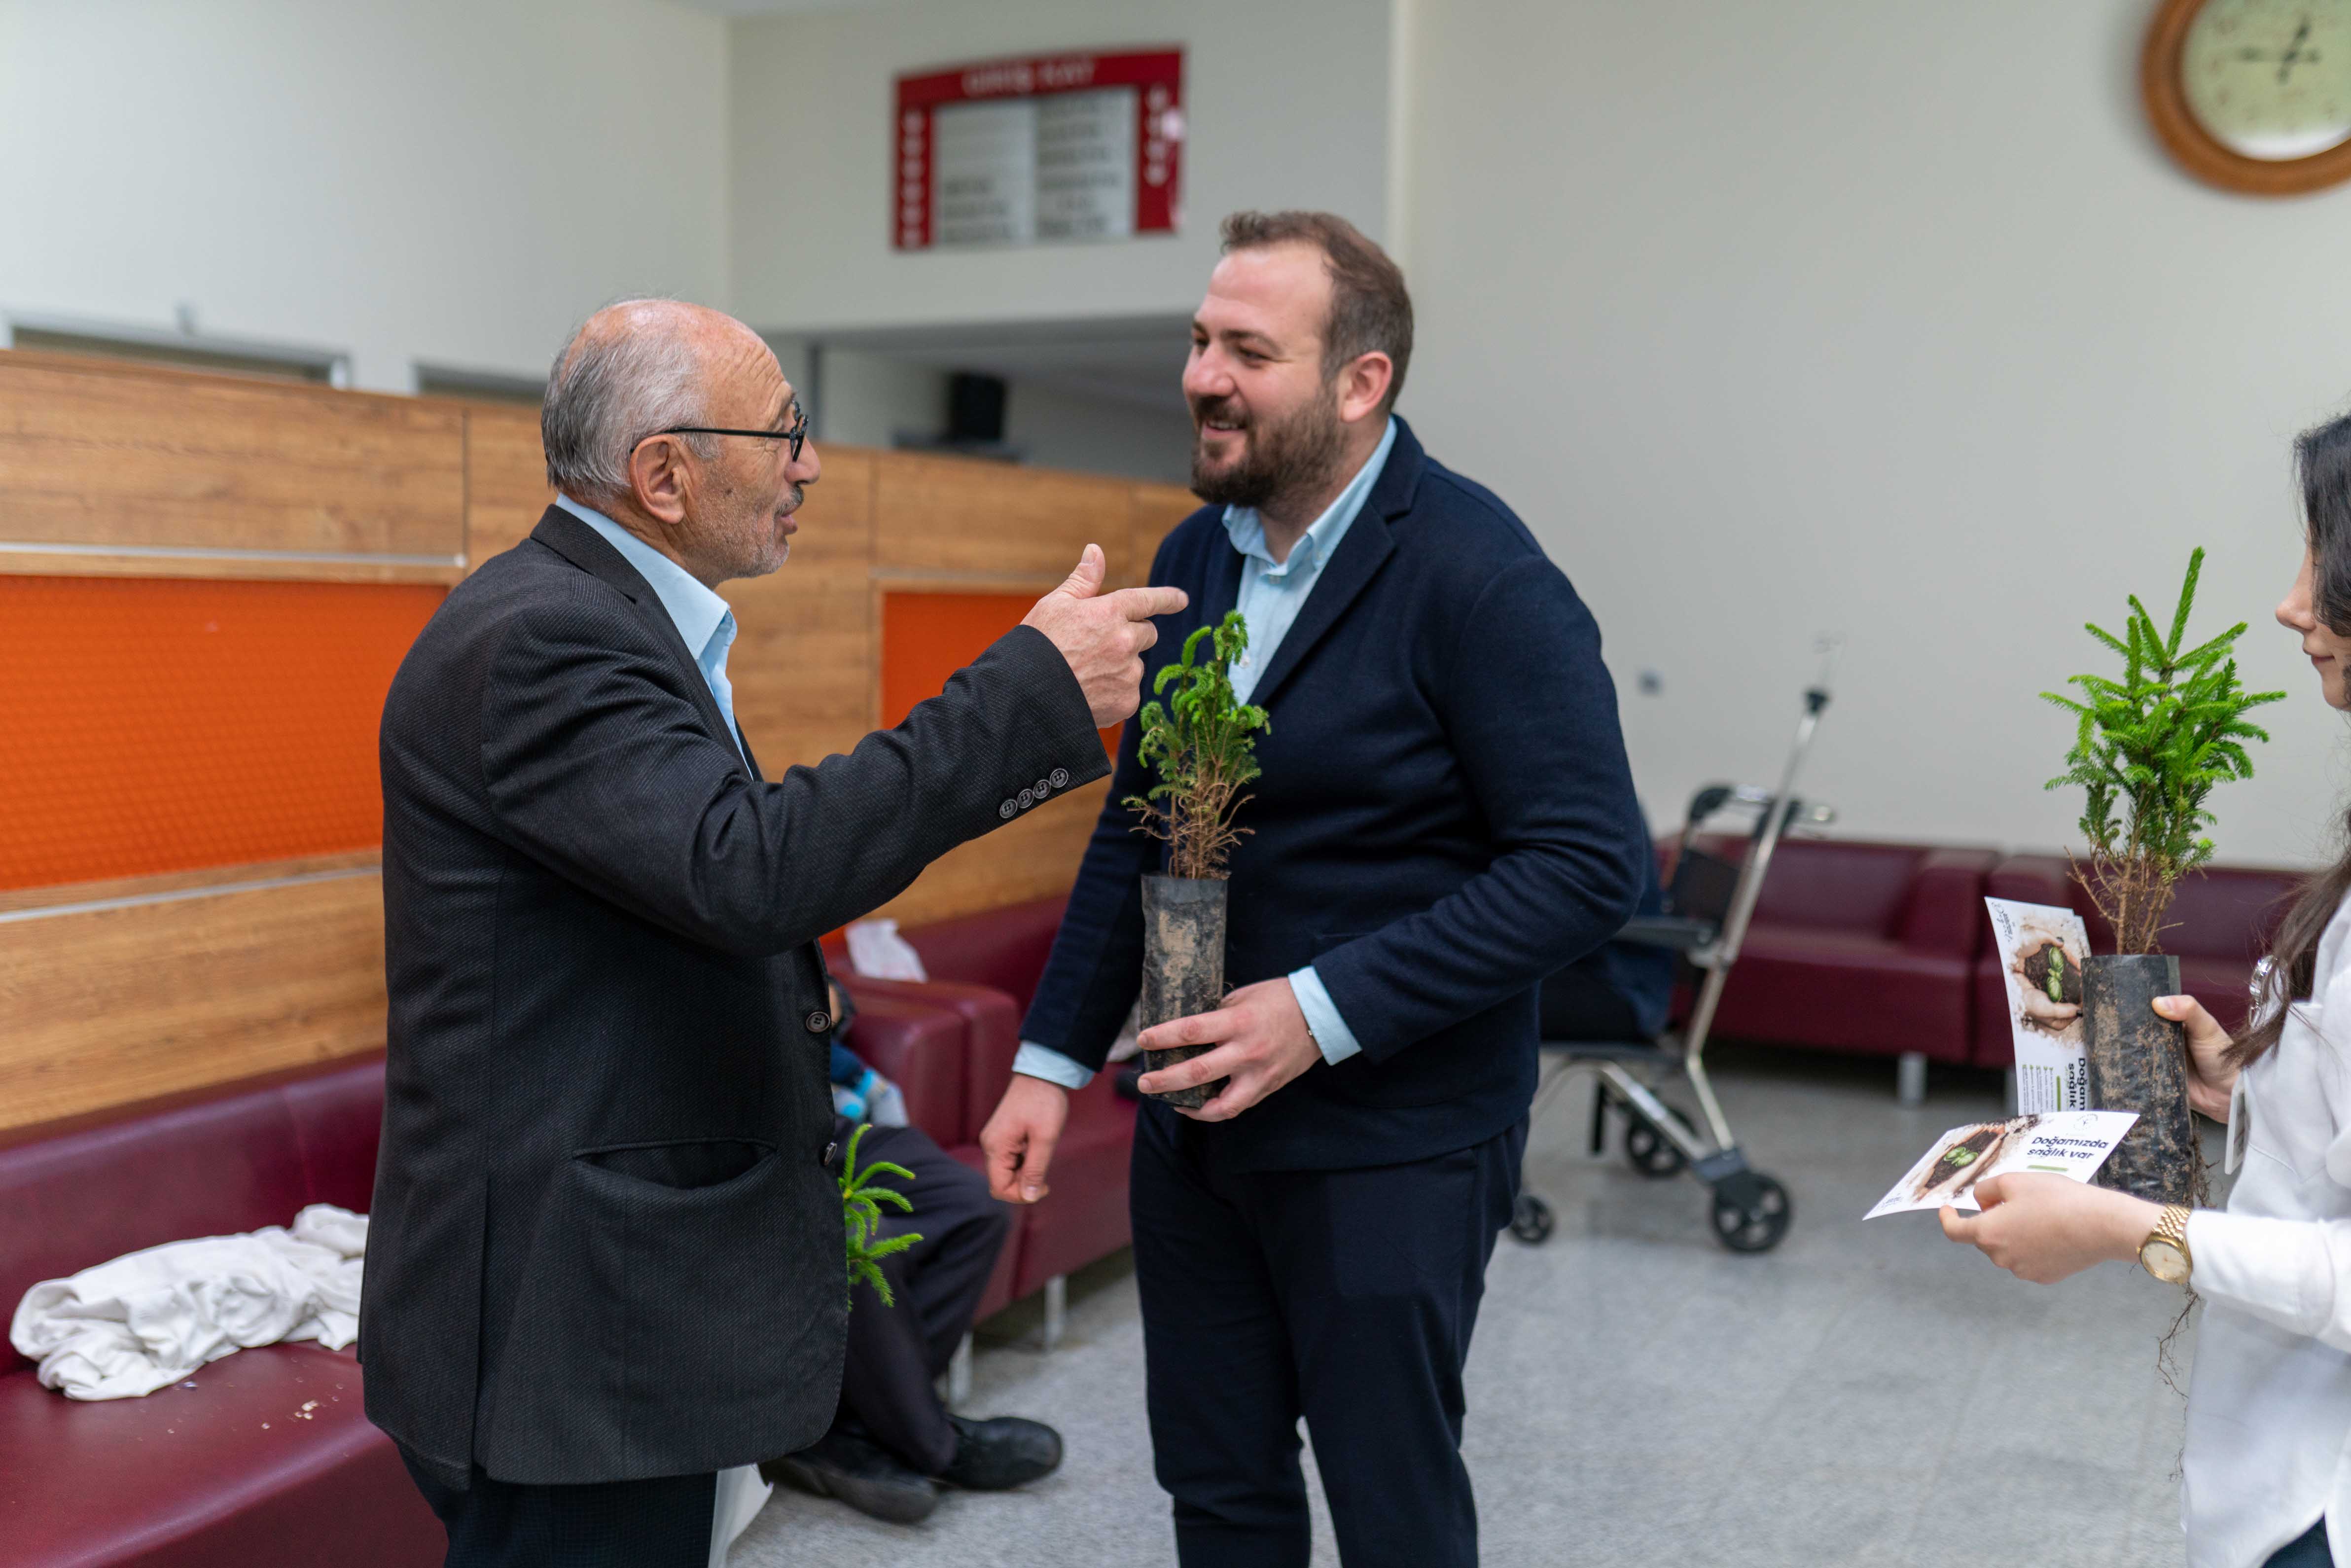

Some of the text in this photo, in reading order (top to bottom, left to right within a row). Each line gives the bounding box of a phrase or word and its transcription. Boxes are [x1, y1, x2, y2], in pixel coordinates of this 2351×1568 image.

[2068, 1063, 2077, 1108] sağlık
[2031, 1136, 2110, 1149] Doğamızda
[2028, 1147, 2095, 1159] sağlık var
